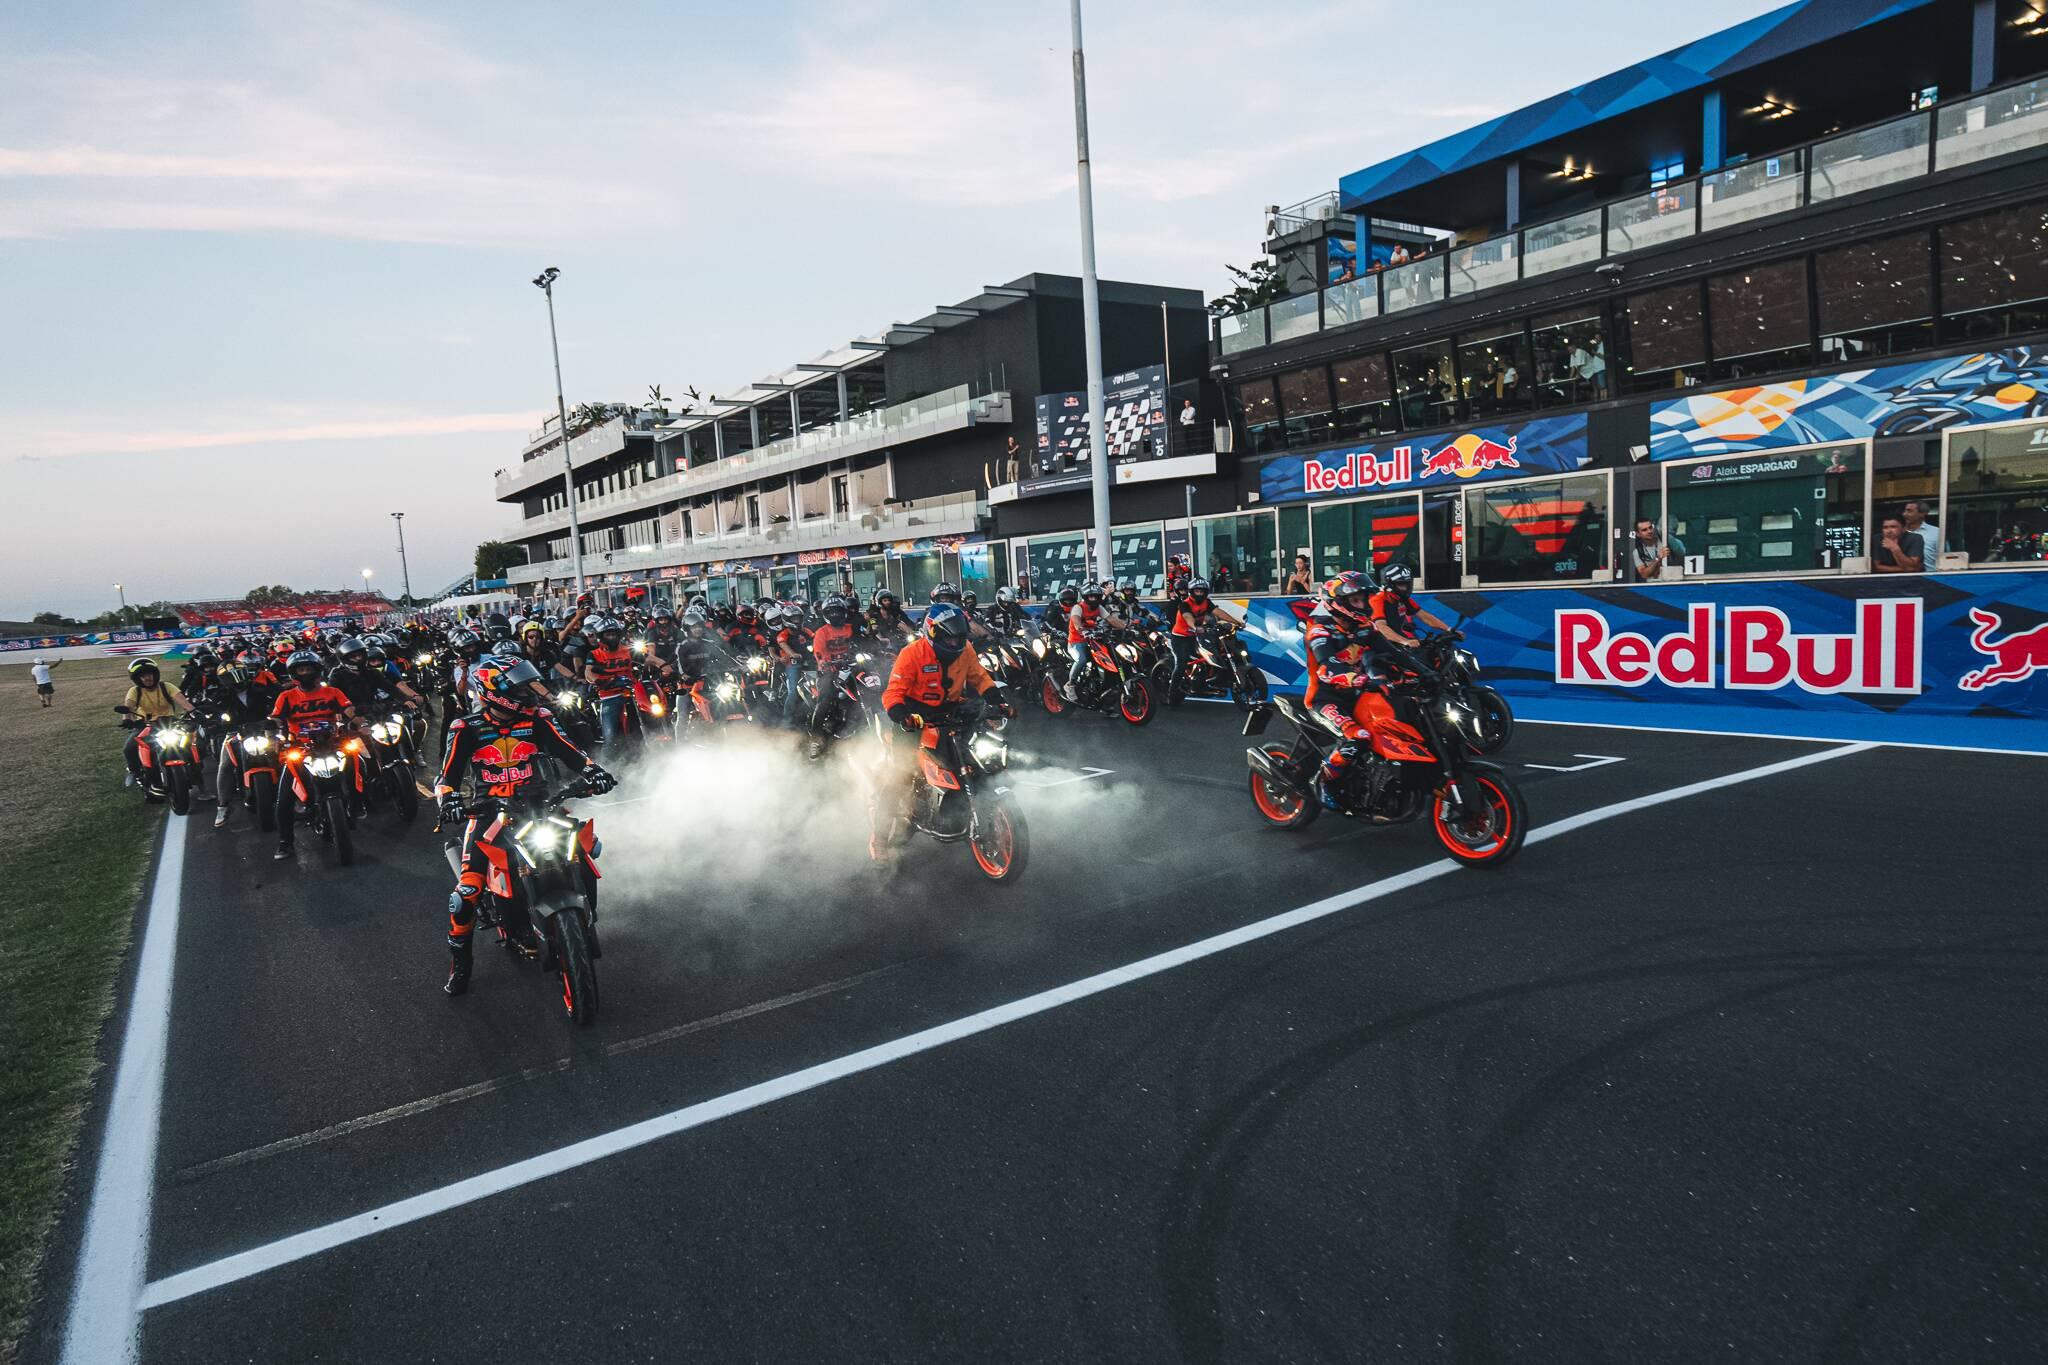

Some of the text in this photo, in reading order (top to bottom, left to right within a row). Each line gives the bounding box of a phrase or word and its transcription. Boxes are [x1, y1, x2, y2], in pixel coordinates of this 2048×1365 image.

[1303, 446, 1412, 493] Red Bull
[1715, 467, 1738, 476] Aleix
[1740, 459, 1798, 474] ESPARGARO
[1454, 500, 1462, 525] racer
[1815, 517, 1825, 526] 41
[1554, 558, 1578, 573] aprilia
[1689, 557, 1698, 574] 1
[1556, 597, 1923, 695] Red Bull
[1320, 703, 1352, 727] Red
[482, 763, 533, 782] Red Bull
